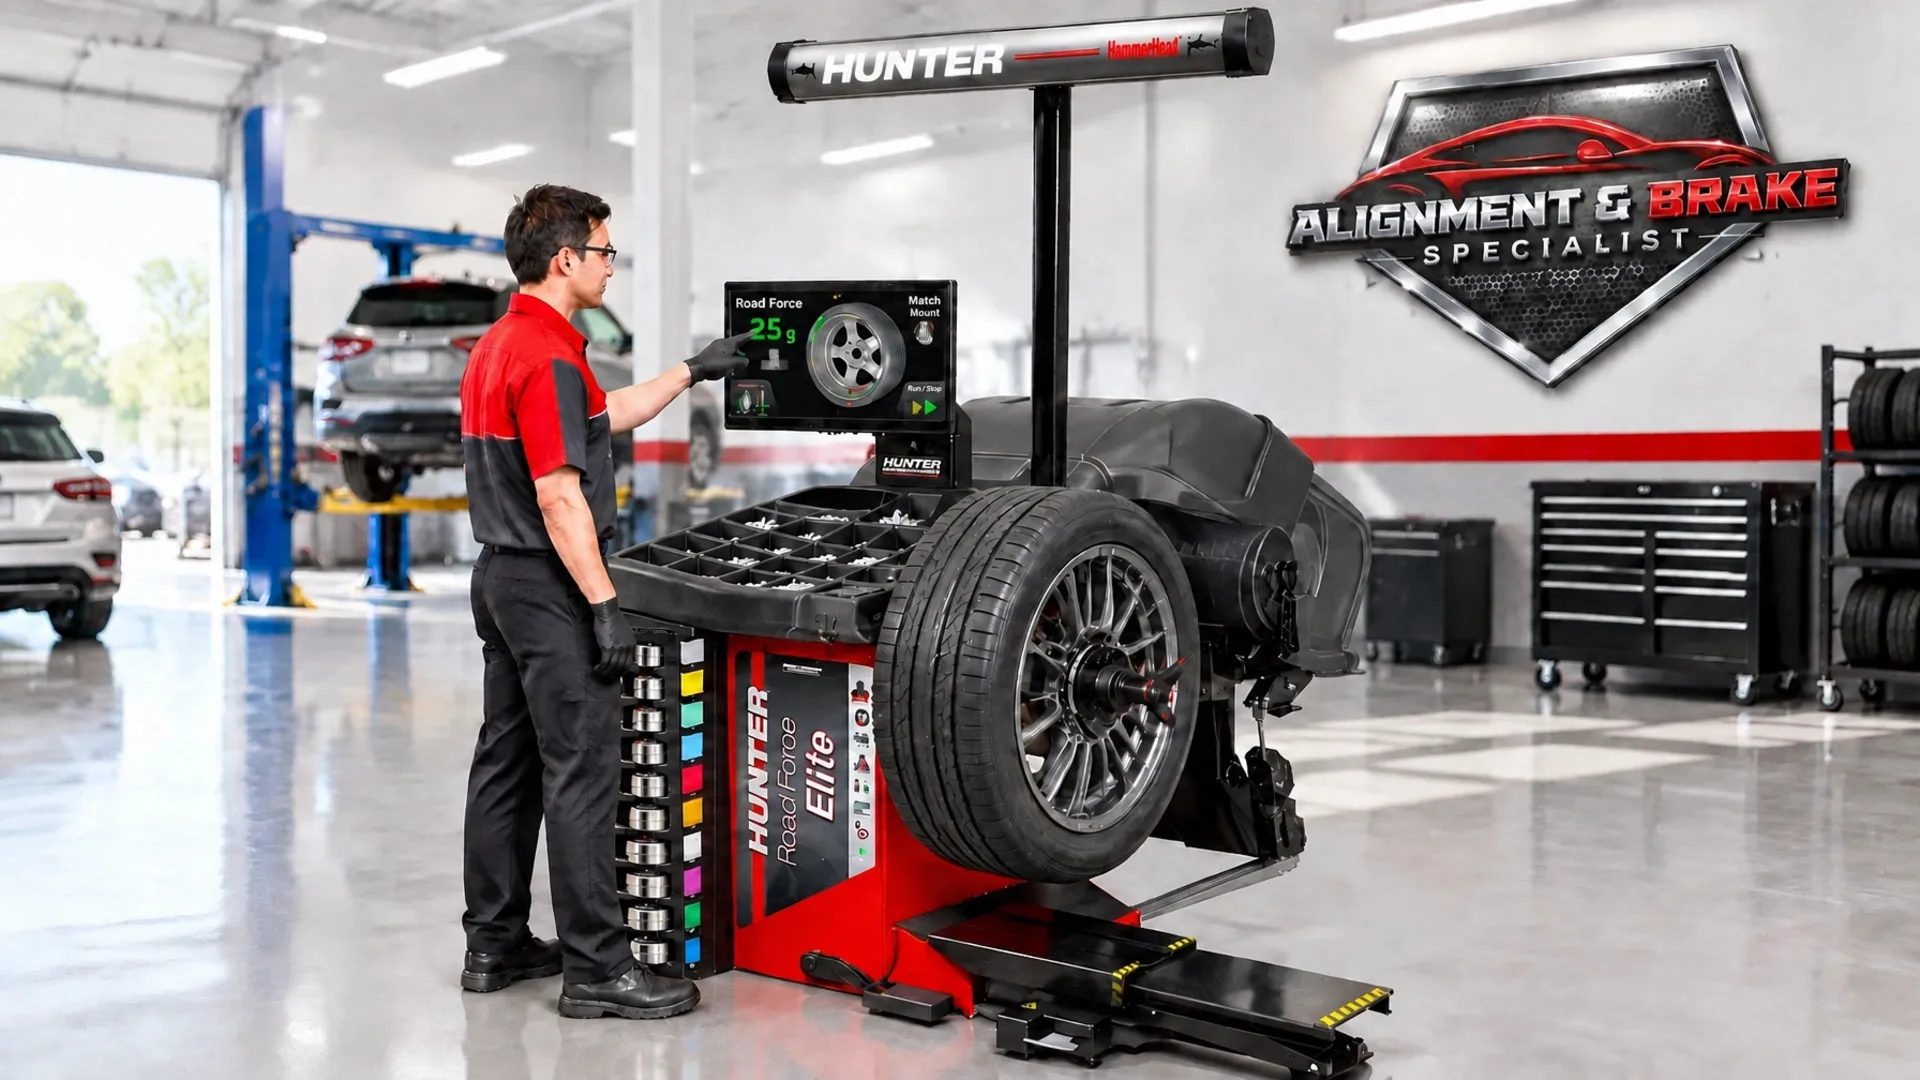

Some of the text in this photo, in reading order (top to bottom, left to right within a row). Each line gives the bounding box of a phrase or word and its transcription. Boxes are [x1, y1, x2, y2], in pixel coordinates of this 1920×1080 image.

[822, 44, 1003, 84] HUNTER
[1107, 38, 1179, 61] HammerHead
[1291, 167, 1839, 244] ALIGNMENT & BRAKE
[1423, 228, 1690, 266] SPECIALIST
[736, 298, 802, 309] Road Force
[908, 296, 941, 306] Match
[910, 309, 940, 317] Mount
[750, 317, 796, 344] 25 g
[882, 457, 942, 469] HUNTER
[747, 686, 769, 855] HUNTER
[805, 729, 836, 822] Elite
[777, 793, 797, 866] Road
